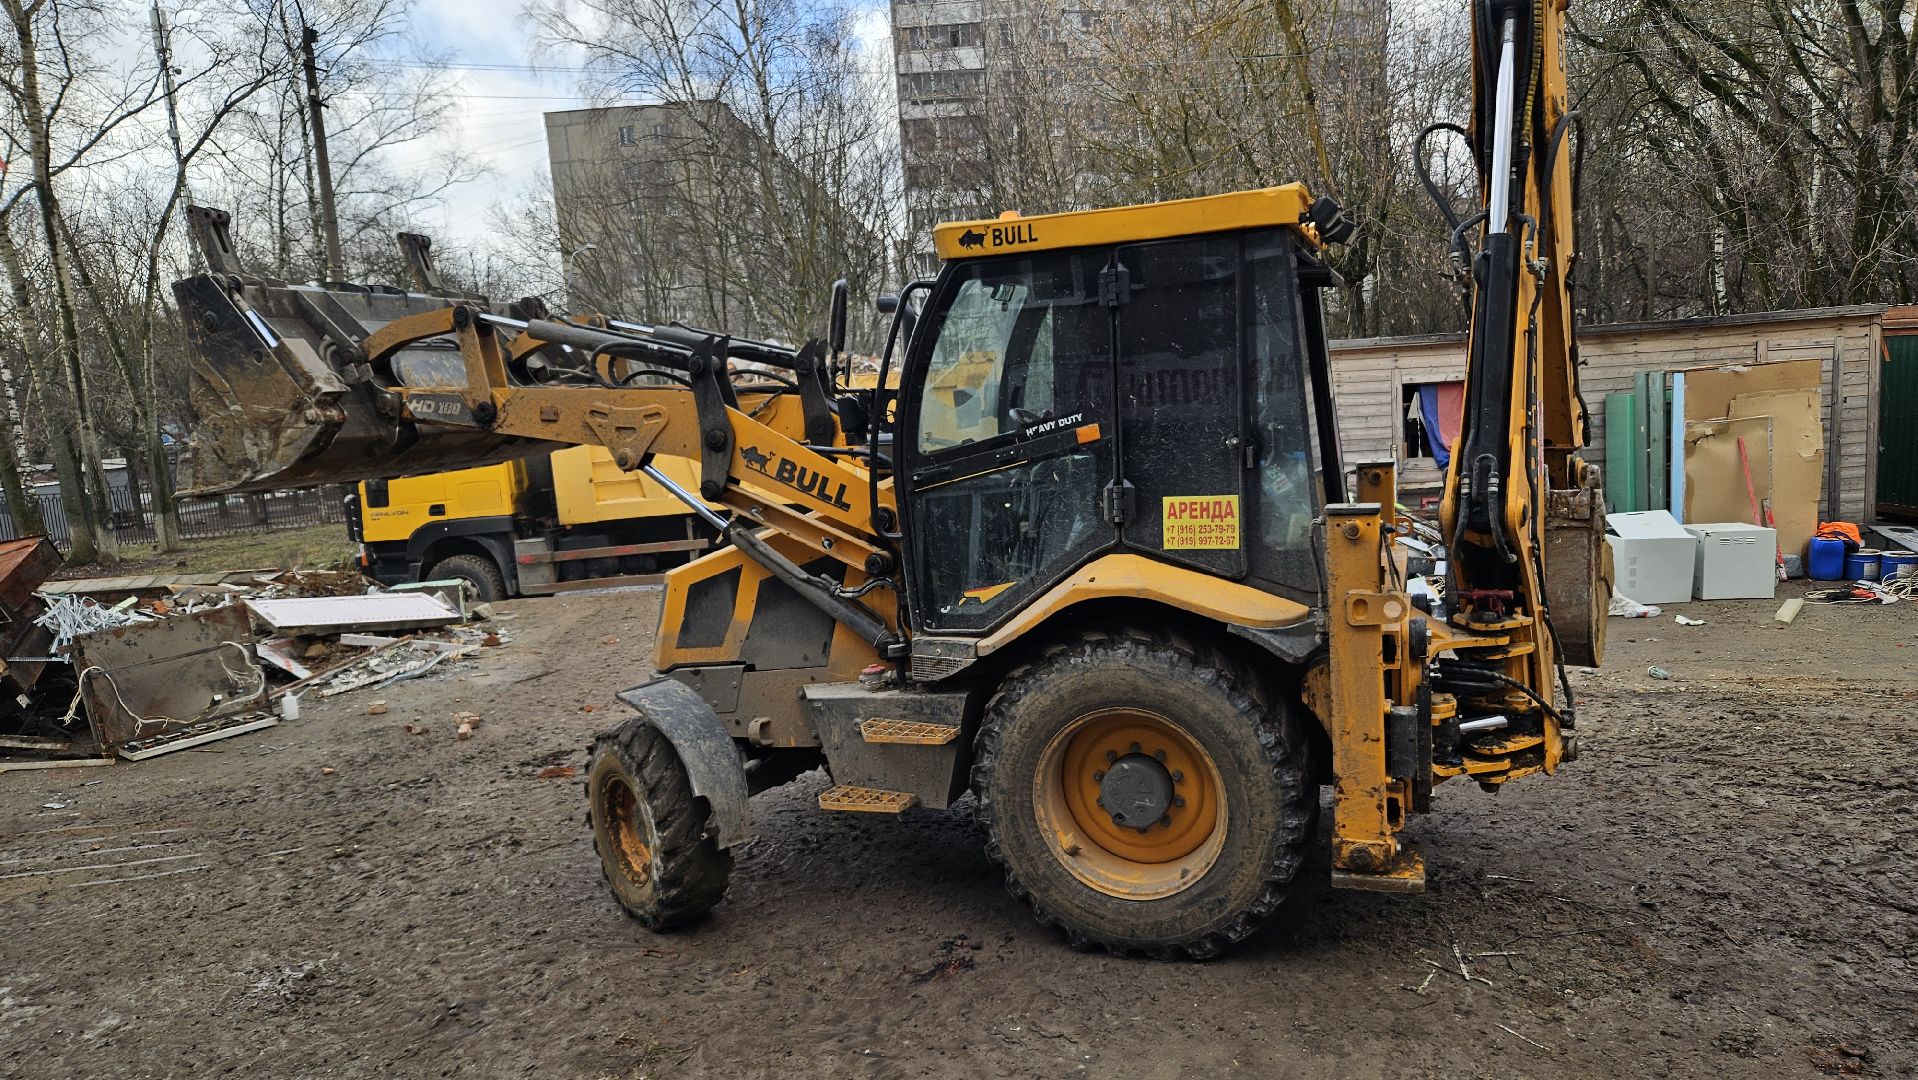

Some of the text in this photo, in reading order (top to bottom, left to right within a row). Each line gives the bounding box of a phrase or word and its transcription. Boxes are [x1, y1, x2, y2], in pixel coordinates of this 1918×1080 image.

[992, 223, 1038, 247] BULL
[407, 399, 435, 413] HD
[1058, 413, 1082, 427] DUTY
[776, 457, 851, 510] BULL
[1167, 500, 1235, 522] АРЕНДА
[1166, 524, 1235, 536] +7 (916) 253-79-79
[1166, 537, 1175, 545] +7
[1177, 536, 1196, 548] (919)
